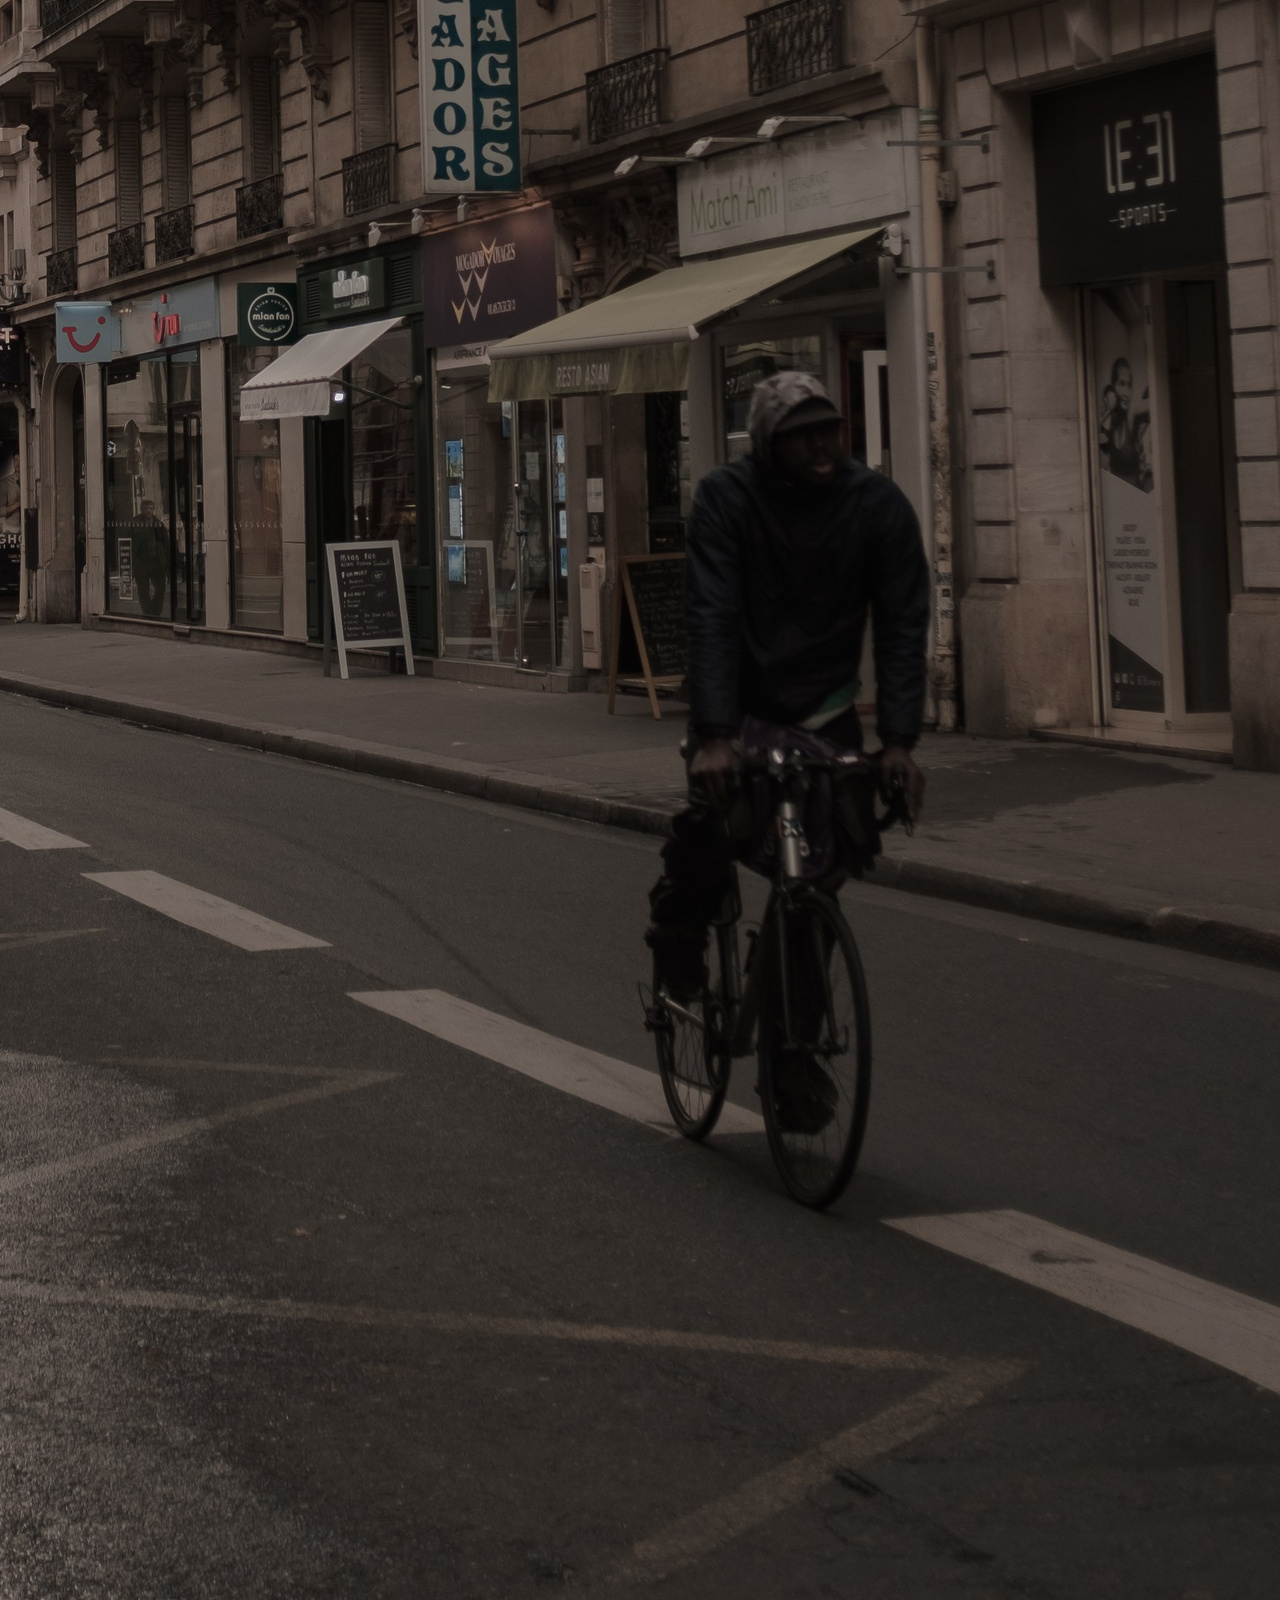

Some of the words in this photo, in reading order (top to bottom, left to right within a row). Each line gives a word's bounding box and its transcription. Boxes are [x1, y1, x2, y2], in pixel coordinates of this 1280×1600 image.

[690, 172, 778, 233] Match'Ami
[253, 313, 274, 321] mian
[275, 311, 290, 321] fan
[556, 365, 581, 387] RESTO
[584, 363, 610, 385] ASIAN
